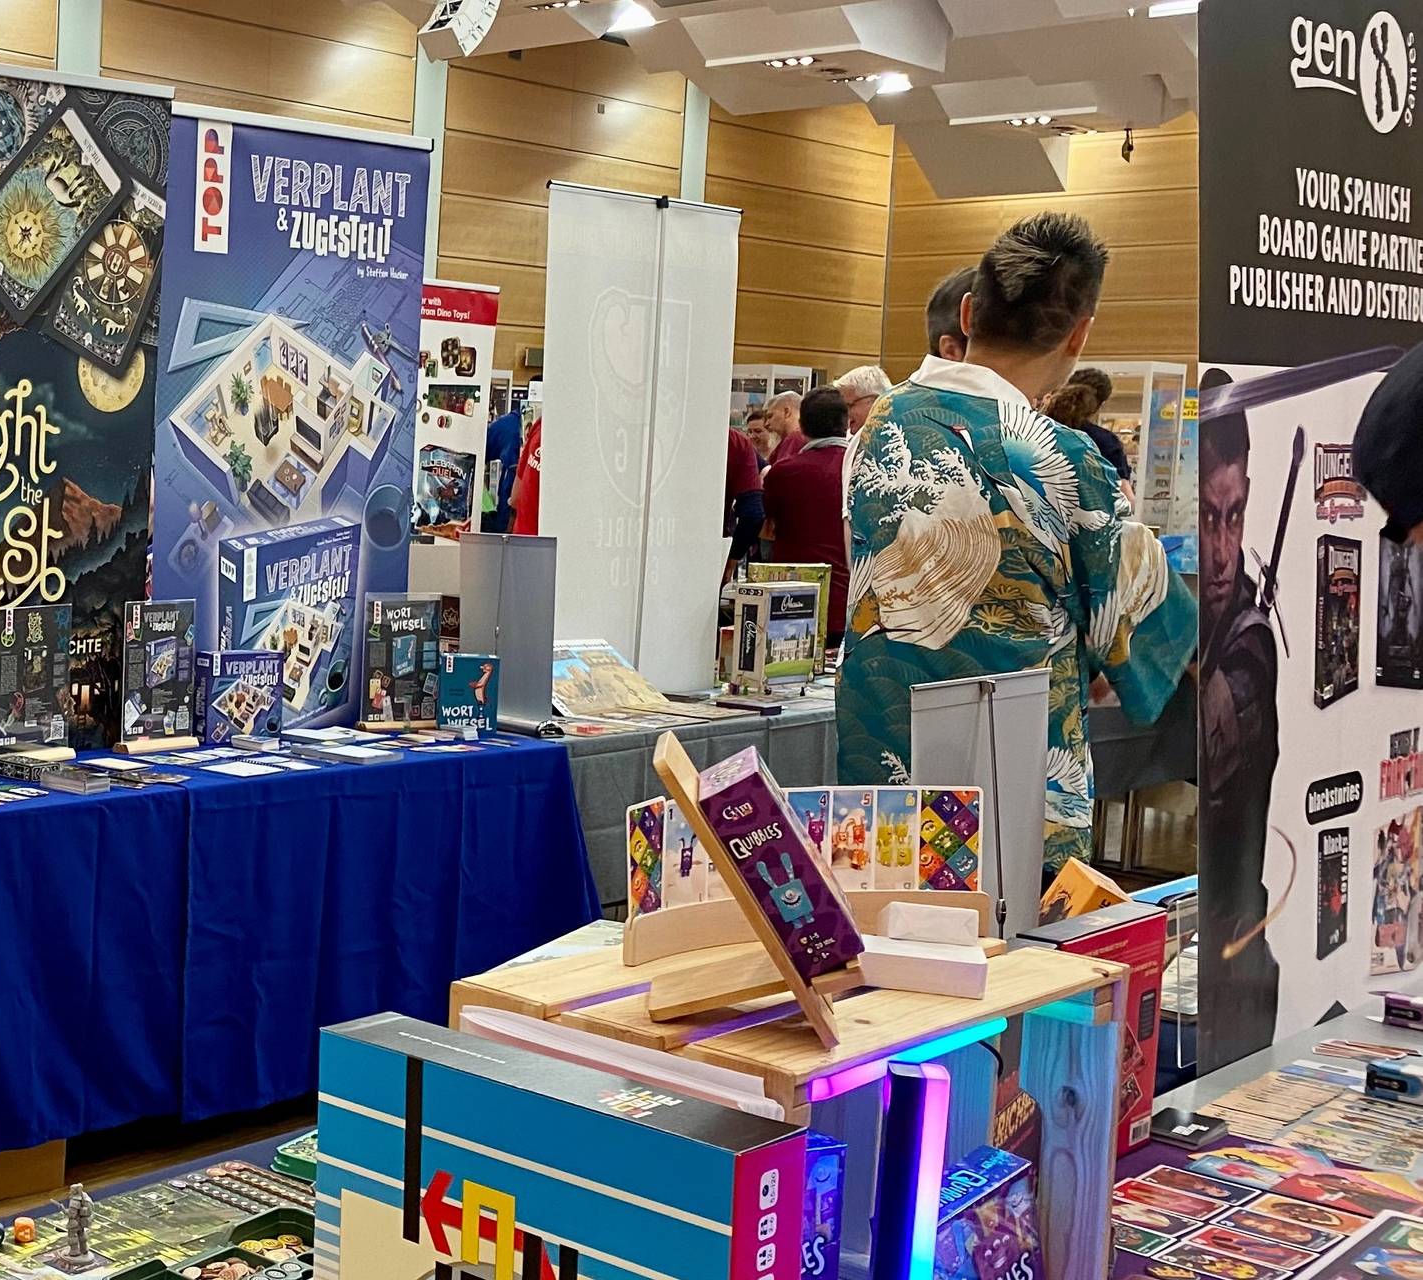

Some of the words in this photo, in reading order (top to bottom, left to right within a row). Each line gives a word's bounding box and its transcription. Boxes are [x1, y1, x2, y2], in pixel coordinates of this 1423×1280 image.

[1290, 16, 1356, 92] gen
[201, 128, 224, 242] TOPP
[250, 154, 411, 218] VERPLANT
[1295, 167, 1340, 213] YOUR
[1344, 176, 1411, 223] SPANISH
[277, 207, 288, 231] &
[290, 211, 393, 263] ZUGESTELLT
[1259, 214, 1318, 260] BOARD
[1322, 224, 1367, 267] GAME
[1370, 231, 1423, 274] PARTNE
[356, 267, 365, 278] by
[365, 266, 389, 278] Steffen
[428, 297, 442, 306] with
[1229, 264, 1325, 313] PUBLISHER
[1327, 277, 1361, 317] AND
[437, 309, 452, 319] Dino
[453, 310, 470, 320] Toys!
[432, 467, 454, 480] DUEL
[21, 477, 43, 505] the
[265, 544, 352, 593] VERPLANT
[297, 570, 350, 607] ZUGESTELLT
[386, 607, 411, 620] WORT
[390, 618, 426, 632] WIESEL
[225, 660, 280, 675] VERPLANT
[442, 705, 474, 718] WORT
[819, 793, 828, 806] 4
[861, 792, 870, 805] 5
[1308, 782, 1360, 814] blackstories
[668, 808, 674, 821] 1
[729, 822, 783, 860] QUIBBLES
